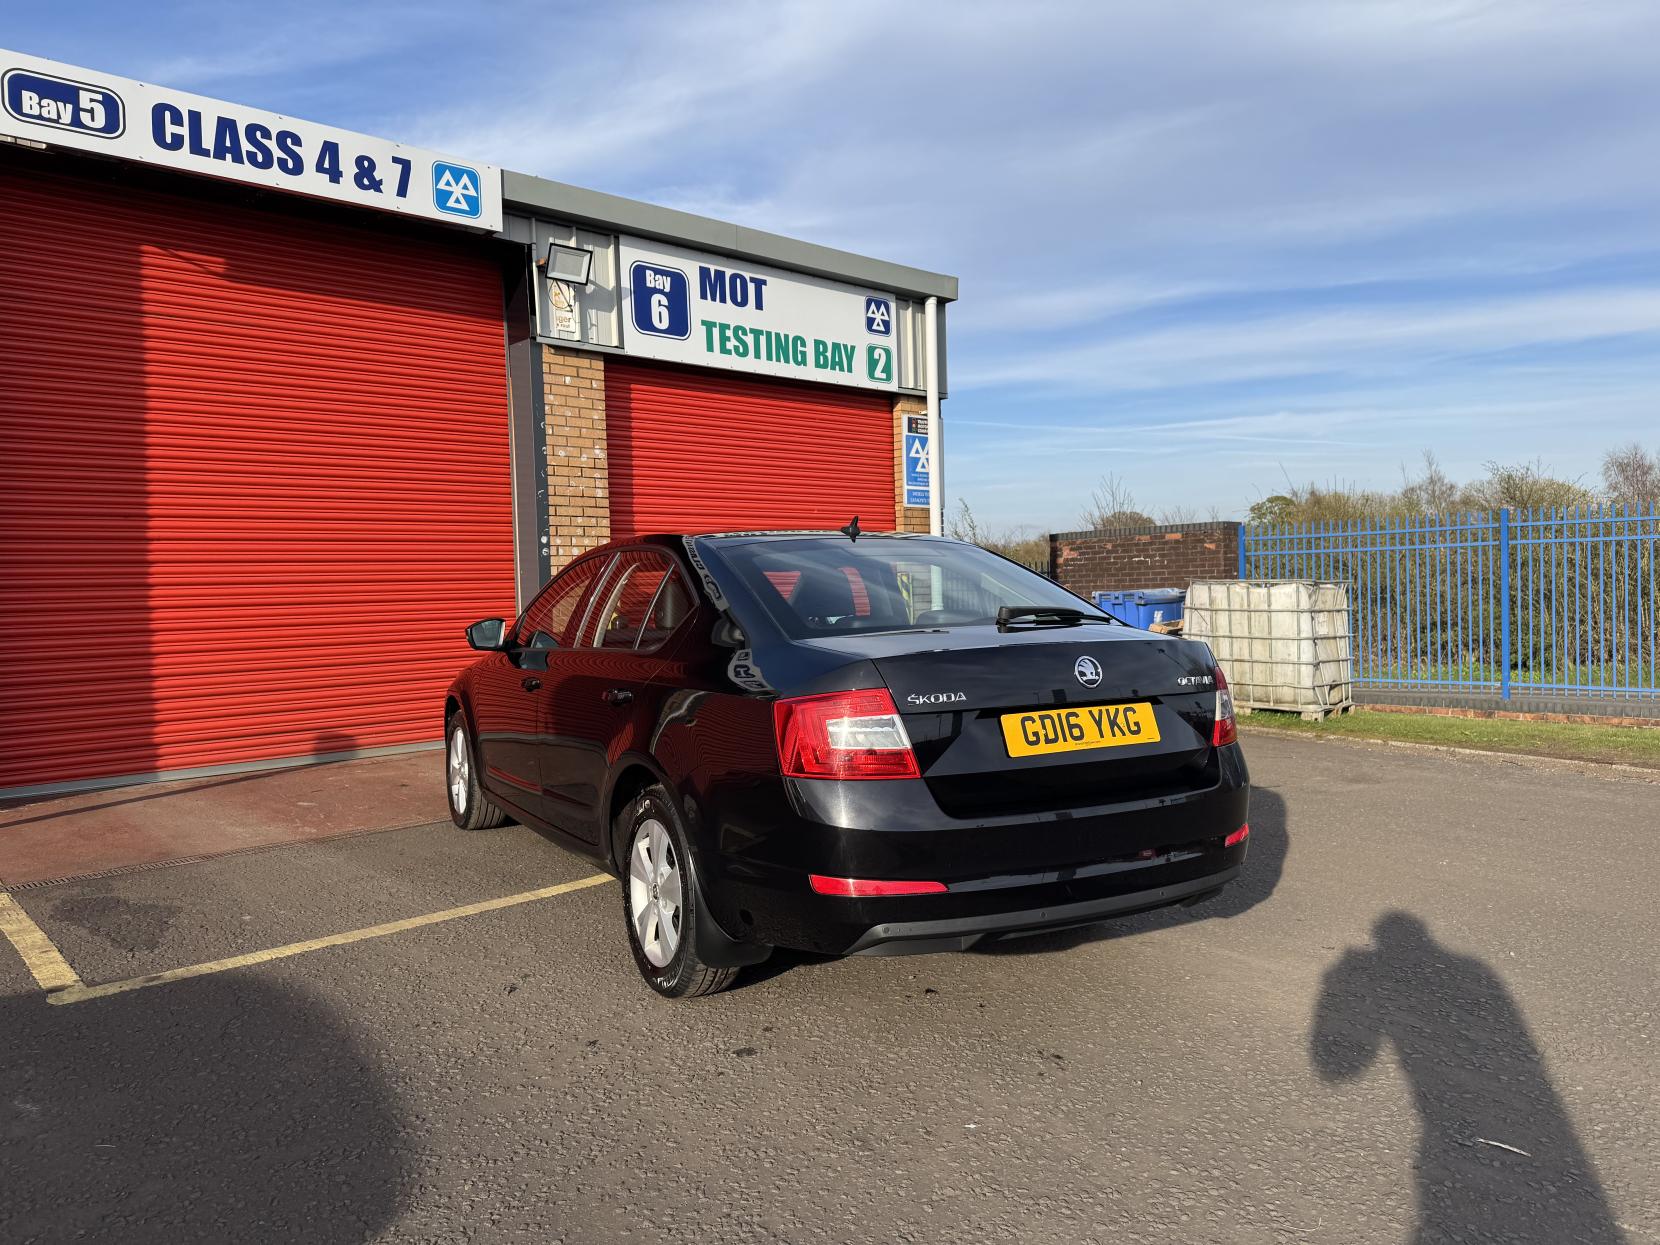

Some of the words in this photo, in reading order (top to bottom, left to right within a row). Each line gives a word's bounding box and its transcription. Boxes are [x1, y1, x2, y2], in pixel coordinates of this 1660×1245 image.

[21, 89, 73, 125] Bay
[79, 89, 106, 130] 5
[151, 102, 304, 176] CLASS
[315, 140, 343, 184] 4
[353, 154, 384, 193] &
[391, 156, 412, 198] 7
[645, 269, 671, 292] Bay
[699, 265, 768, 311] MOT
[651, 293, 669, 331] 6
[700, 319, 808, 366] TESTING
[814, 338, 856, 374] BAY
[873, 348, 888, 381] 2
[1020, 712, 1086, 747] GD16
[1088, 706, 1142, 740] YKG
